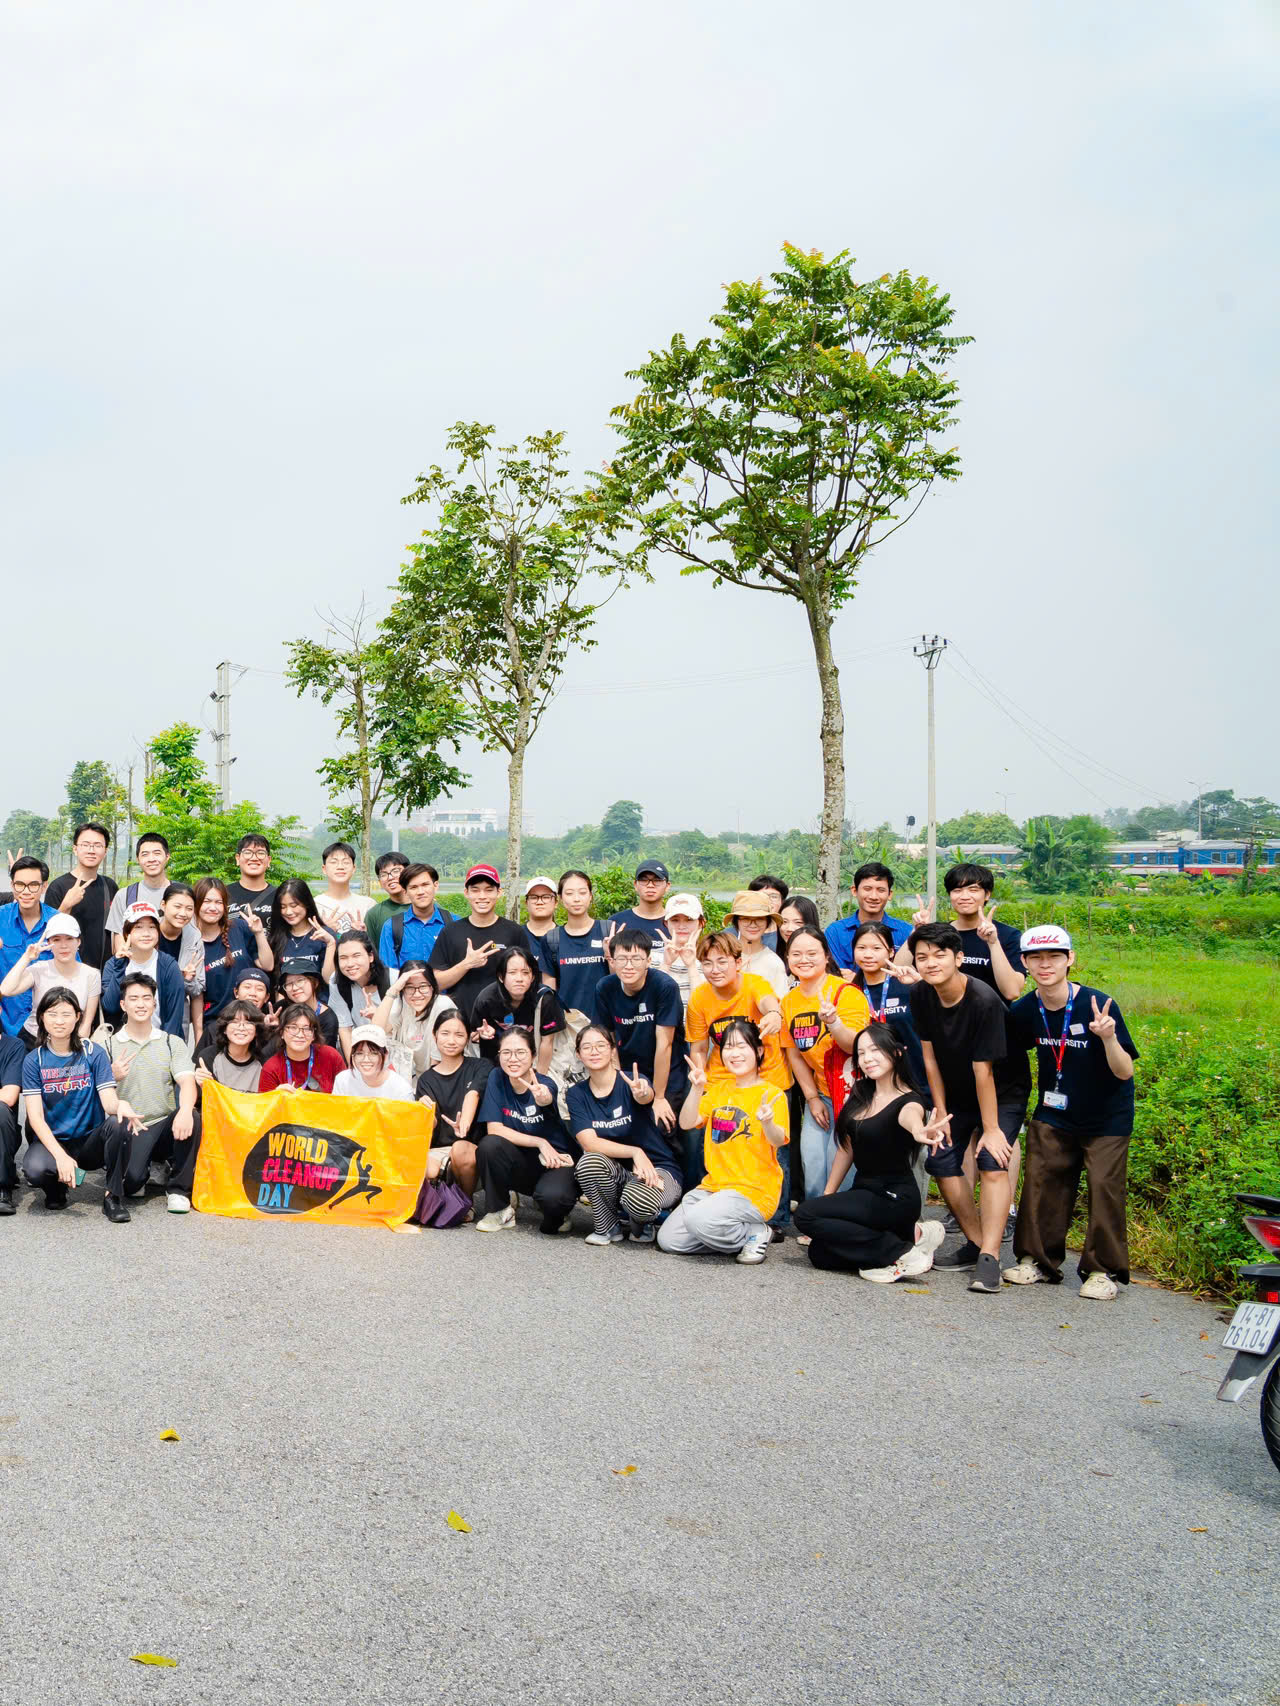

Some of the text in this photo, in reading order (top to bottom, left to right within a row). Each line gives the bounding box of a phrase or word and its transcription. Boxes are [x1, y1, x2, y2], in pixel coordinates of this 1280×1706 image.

[43, 1077, 91, 1093] STORM
[268, 1132, 328, 1164] WORLD
[262, 1157, 340, 1191] CLEANUP
[257, 1183, 294, 1208] DAY
[1239, 1304, 1276, 1328] 14-B1
[1223, 1324, 1270, 1350] 761.04
